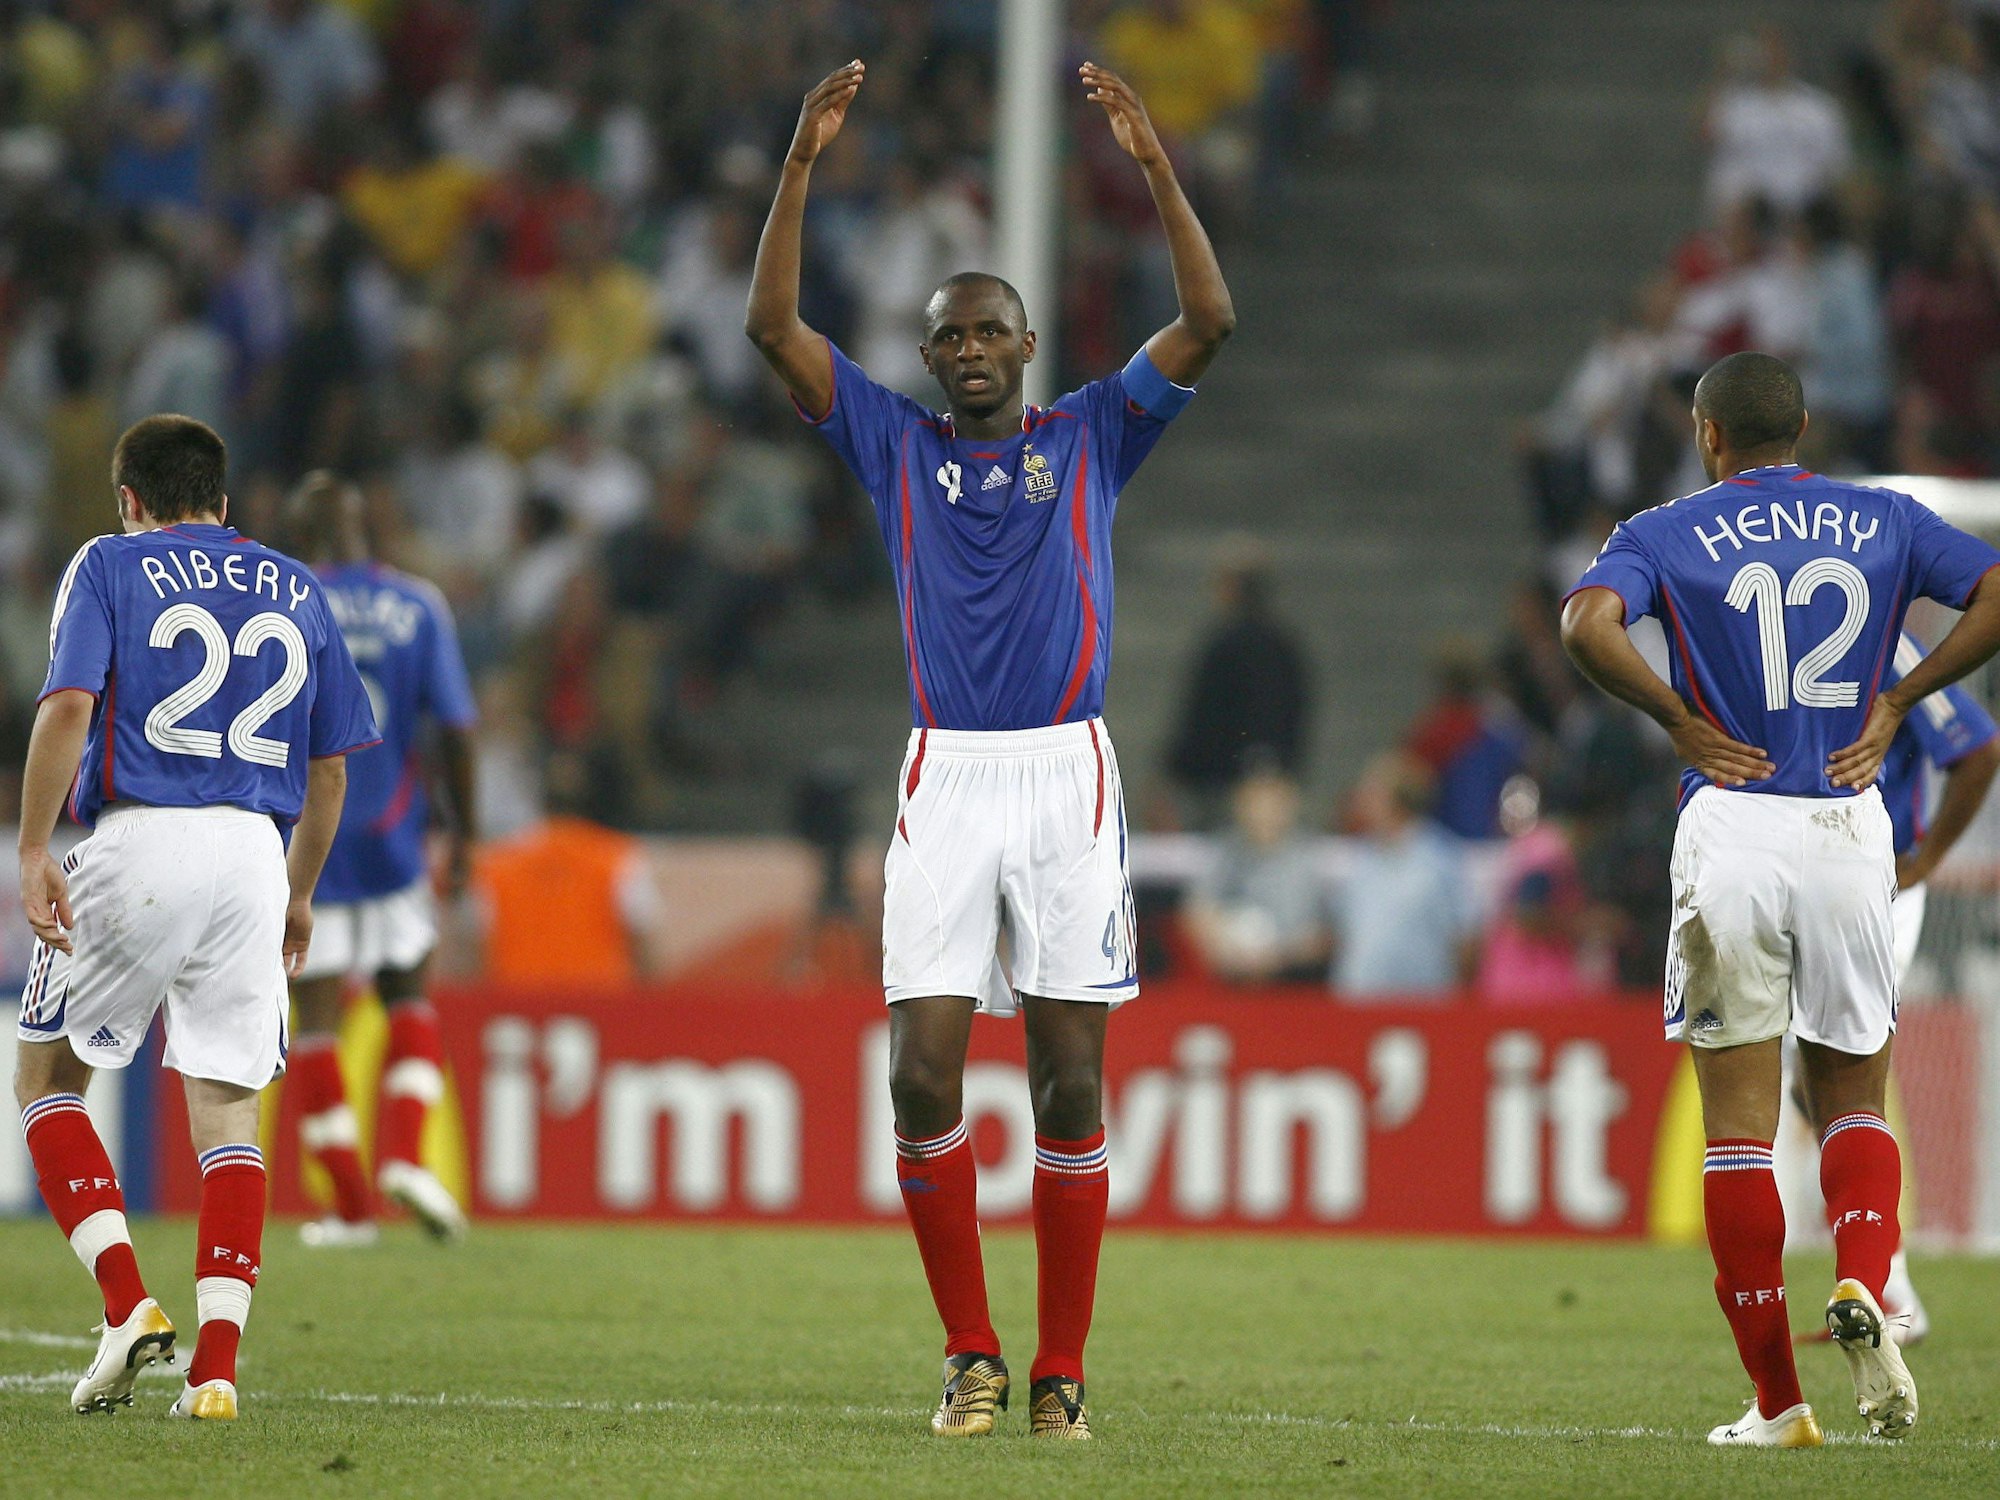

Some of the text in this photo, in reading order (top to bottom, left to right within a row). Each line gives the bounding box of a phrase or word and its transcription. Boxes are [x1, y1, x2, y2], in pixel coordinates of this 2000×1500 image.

[981, 475, 1013, 491] adidas
[1693, 500, 1880, 563] HENRY
[141, 549, 310, 612] RIBERY
[1723, 557, 1872, 712] 12
[144, 603, 308, 768] 22
[1101, 910, 1117, 971] 4
[87, 1037, 121, 1047] adidas
[1689, 1018, 1725, 1029] adidas
[477, 1013, 802, 1211] i'm
[1483, 1027, 1630, 1230] it
